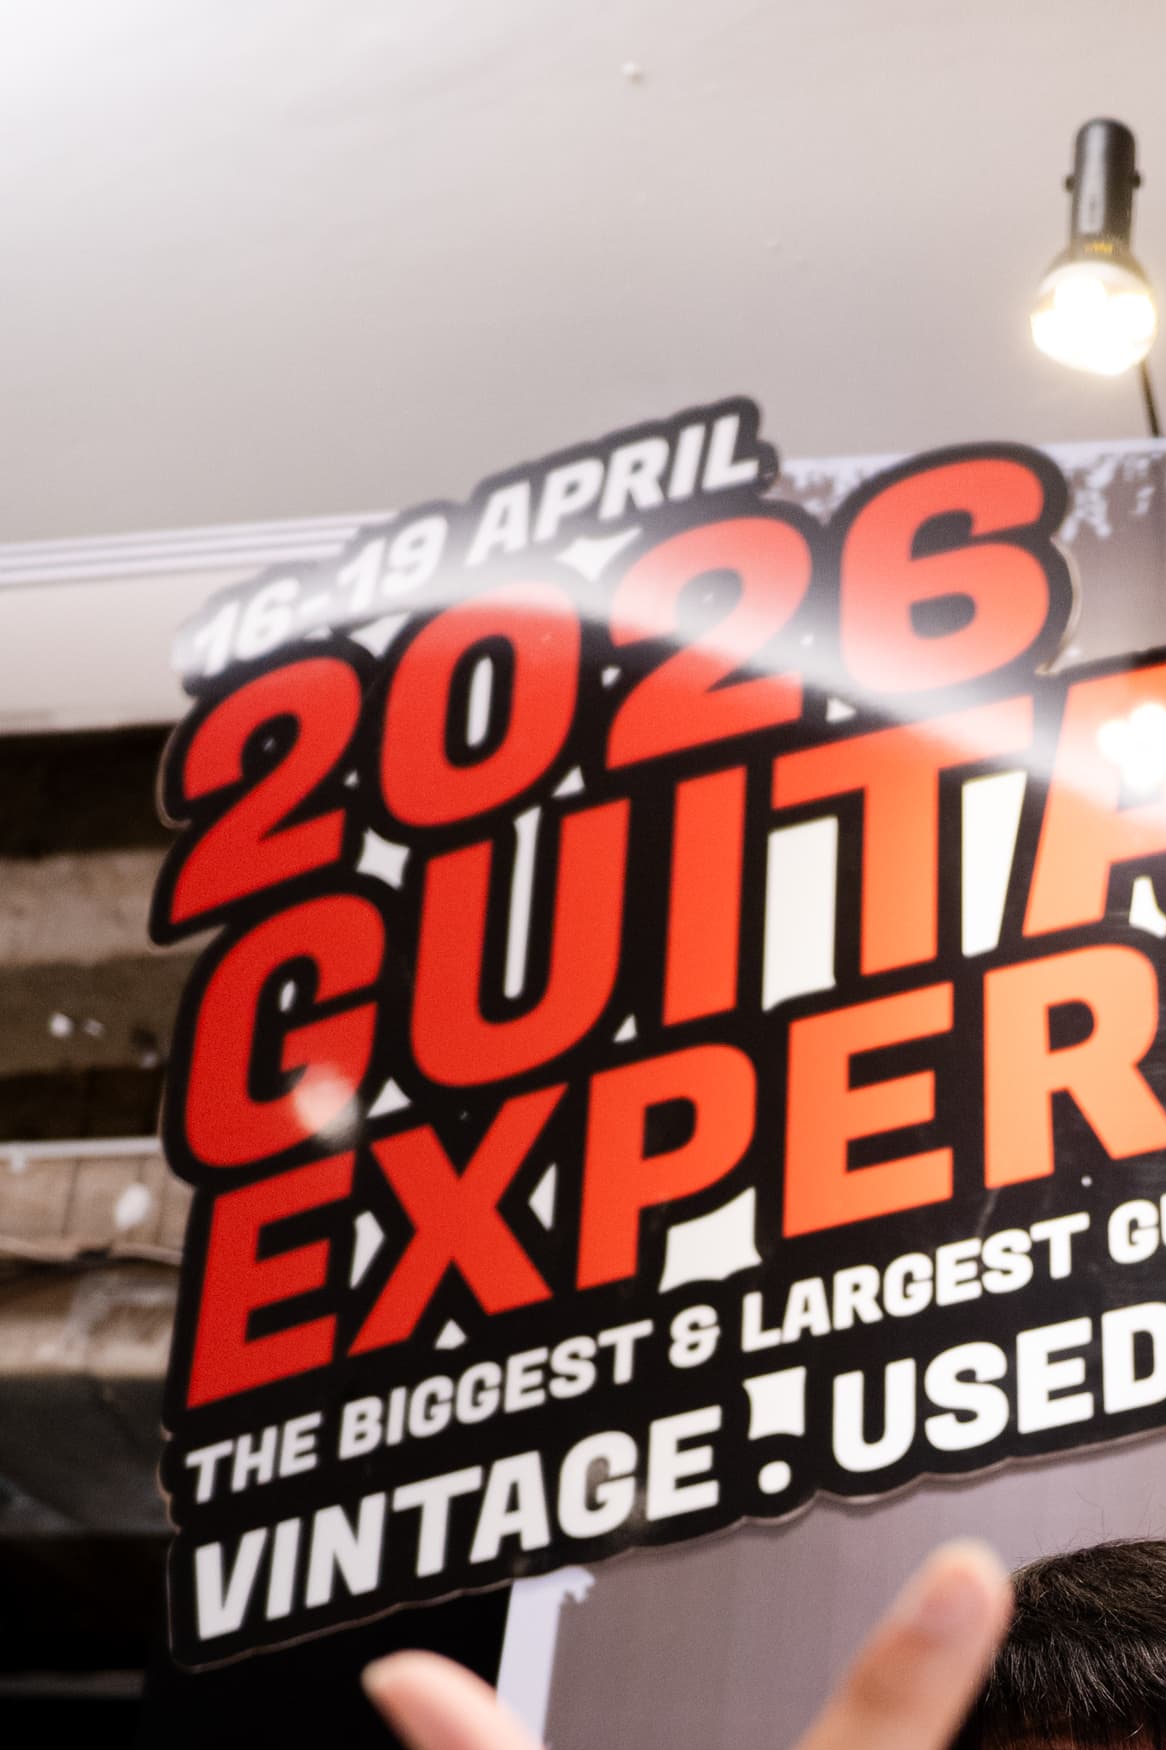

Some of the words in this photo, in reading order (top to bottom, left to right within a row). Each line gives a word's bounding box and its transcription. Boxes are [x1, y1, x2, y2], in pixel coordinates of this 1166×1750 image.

[192, 514, 450, 674] 16-19
[467, 413, 761, 566] APRIL
[170, 458, 1051, 924] 2026
[186, 1413, 322, 1503] THE
[338, 1320, 654, 1460] BIGGEST
[668, 1304, 721, 1369] &
[741, 1212, 1091, 1353] LARGEST
[195, 1404, 724, 1641] VINTAGE
